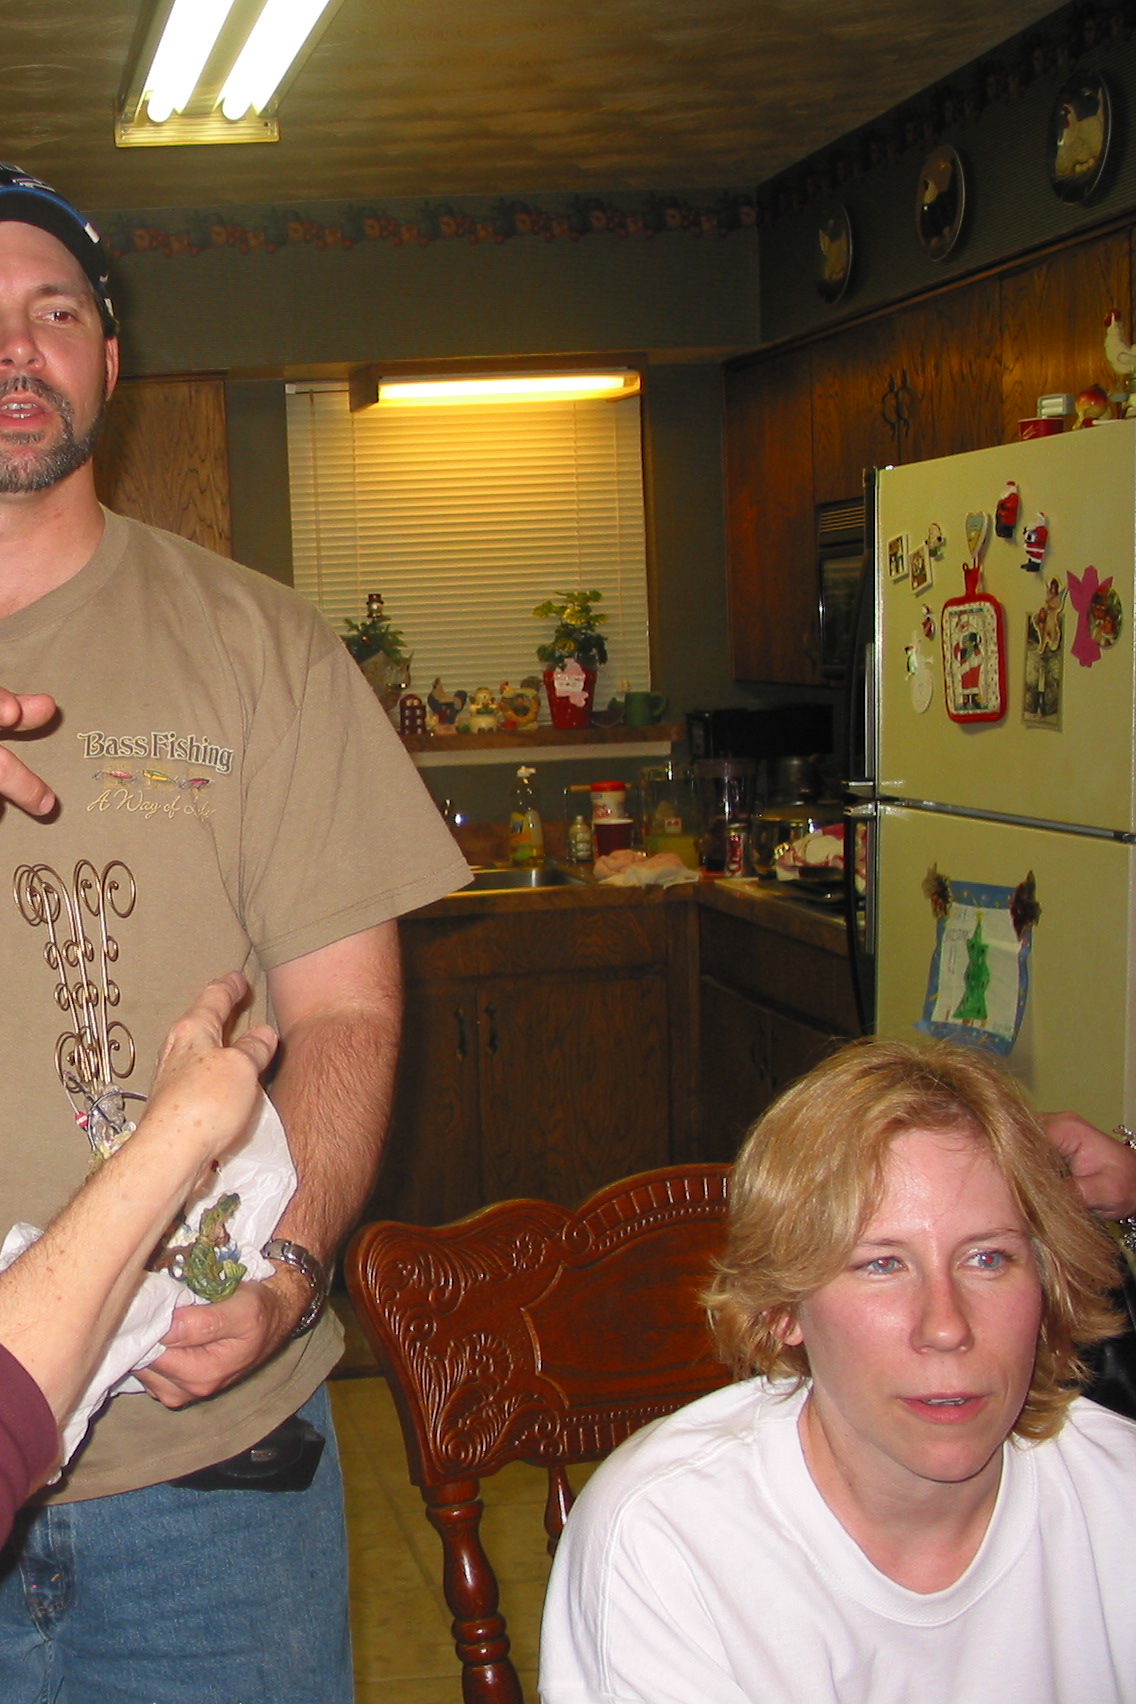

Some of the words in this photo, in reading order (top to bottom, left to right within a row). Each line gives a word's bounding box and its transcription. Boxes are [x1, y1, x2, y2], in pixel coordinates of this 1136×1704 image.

[77, 730, 149, 759] Bass
[150, 730, 234, 775] Fishing
[86, 789, 111, 812] A
[113, 788, 162, 819] Way
[163, 795, 181, 819] of
